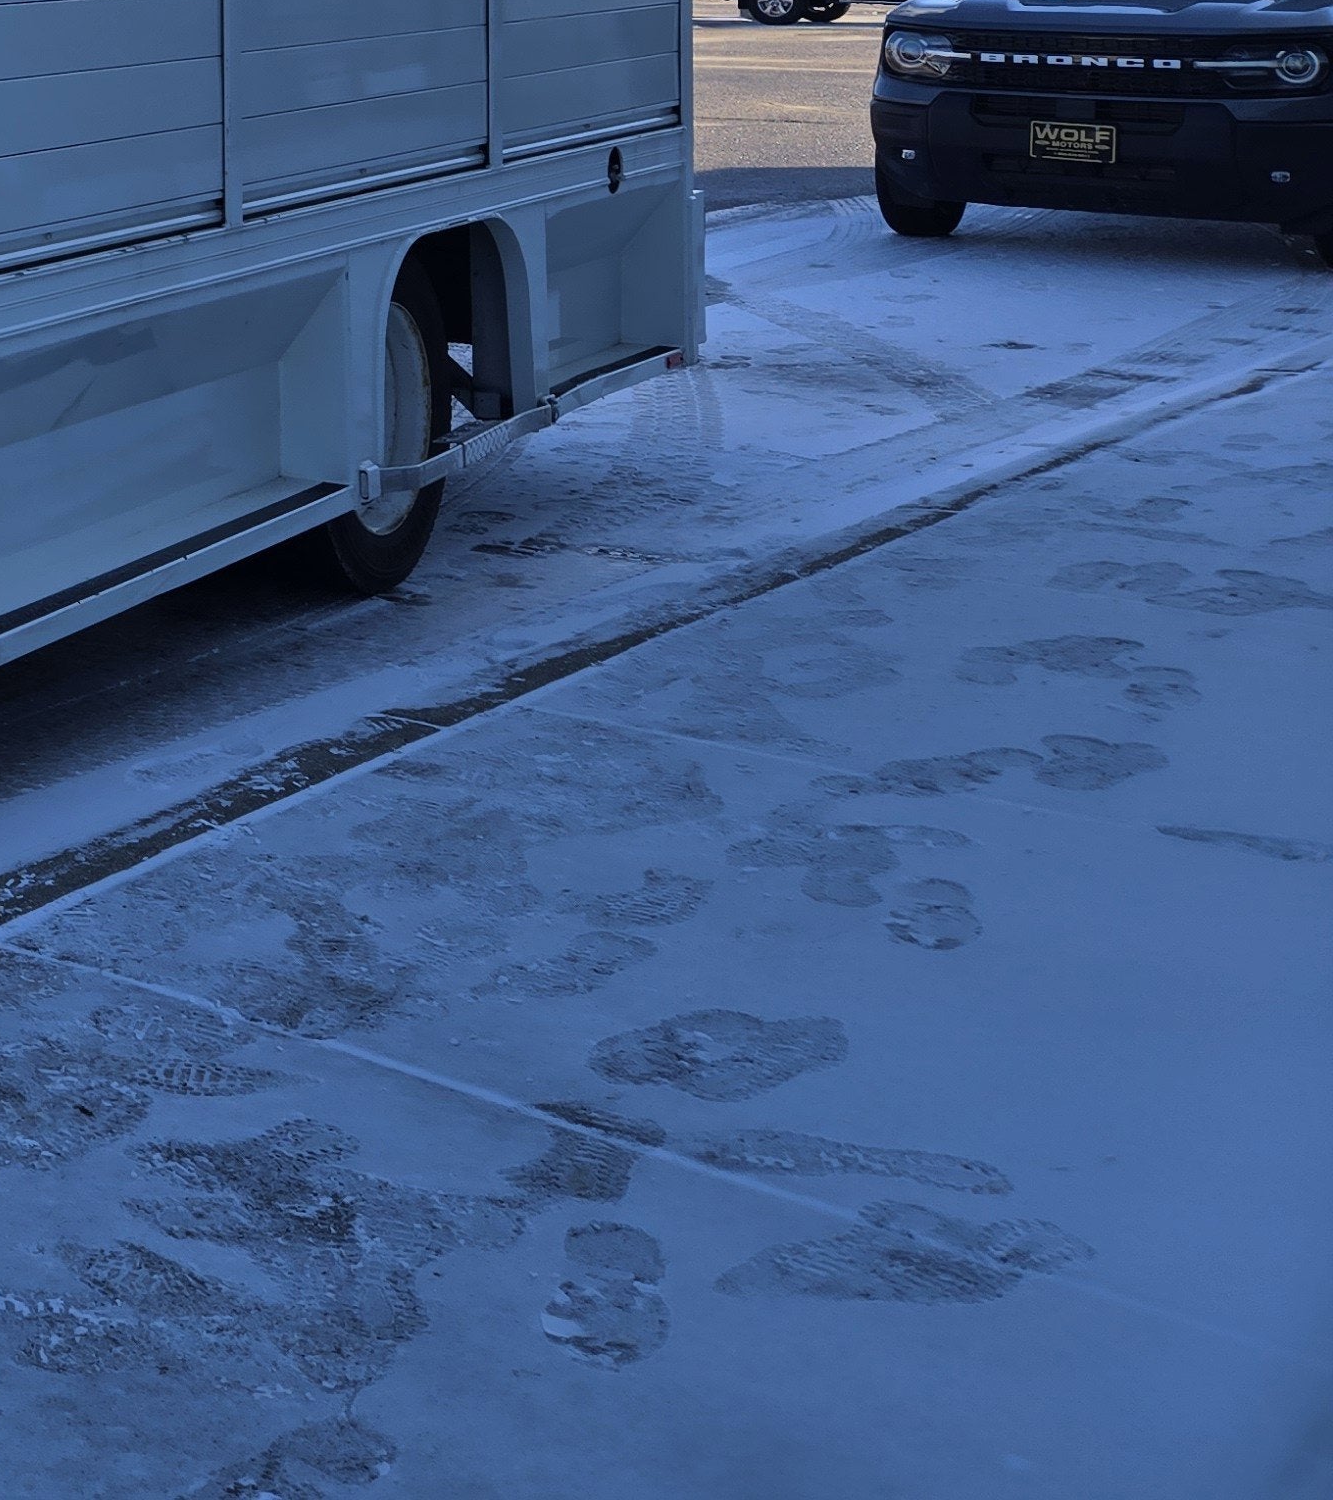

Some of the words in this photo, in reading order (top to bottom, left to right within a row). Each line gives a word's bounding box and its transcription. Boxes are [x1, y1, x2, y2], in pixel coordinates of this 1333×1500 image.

[980, 52, 1182, 69] BRONCO
[1035, 126, 1110, 143] WOLF
[1051, 141, 1093, 150] MOTORS
